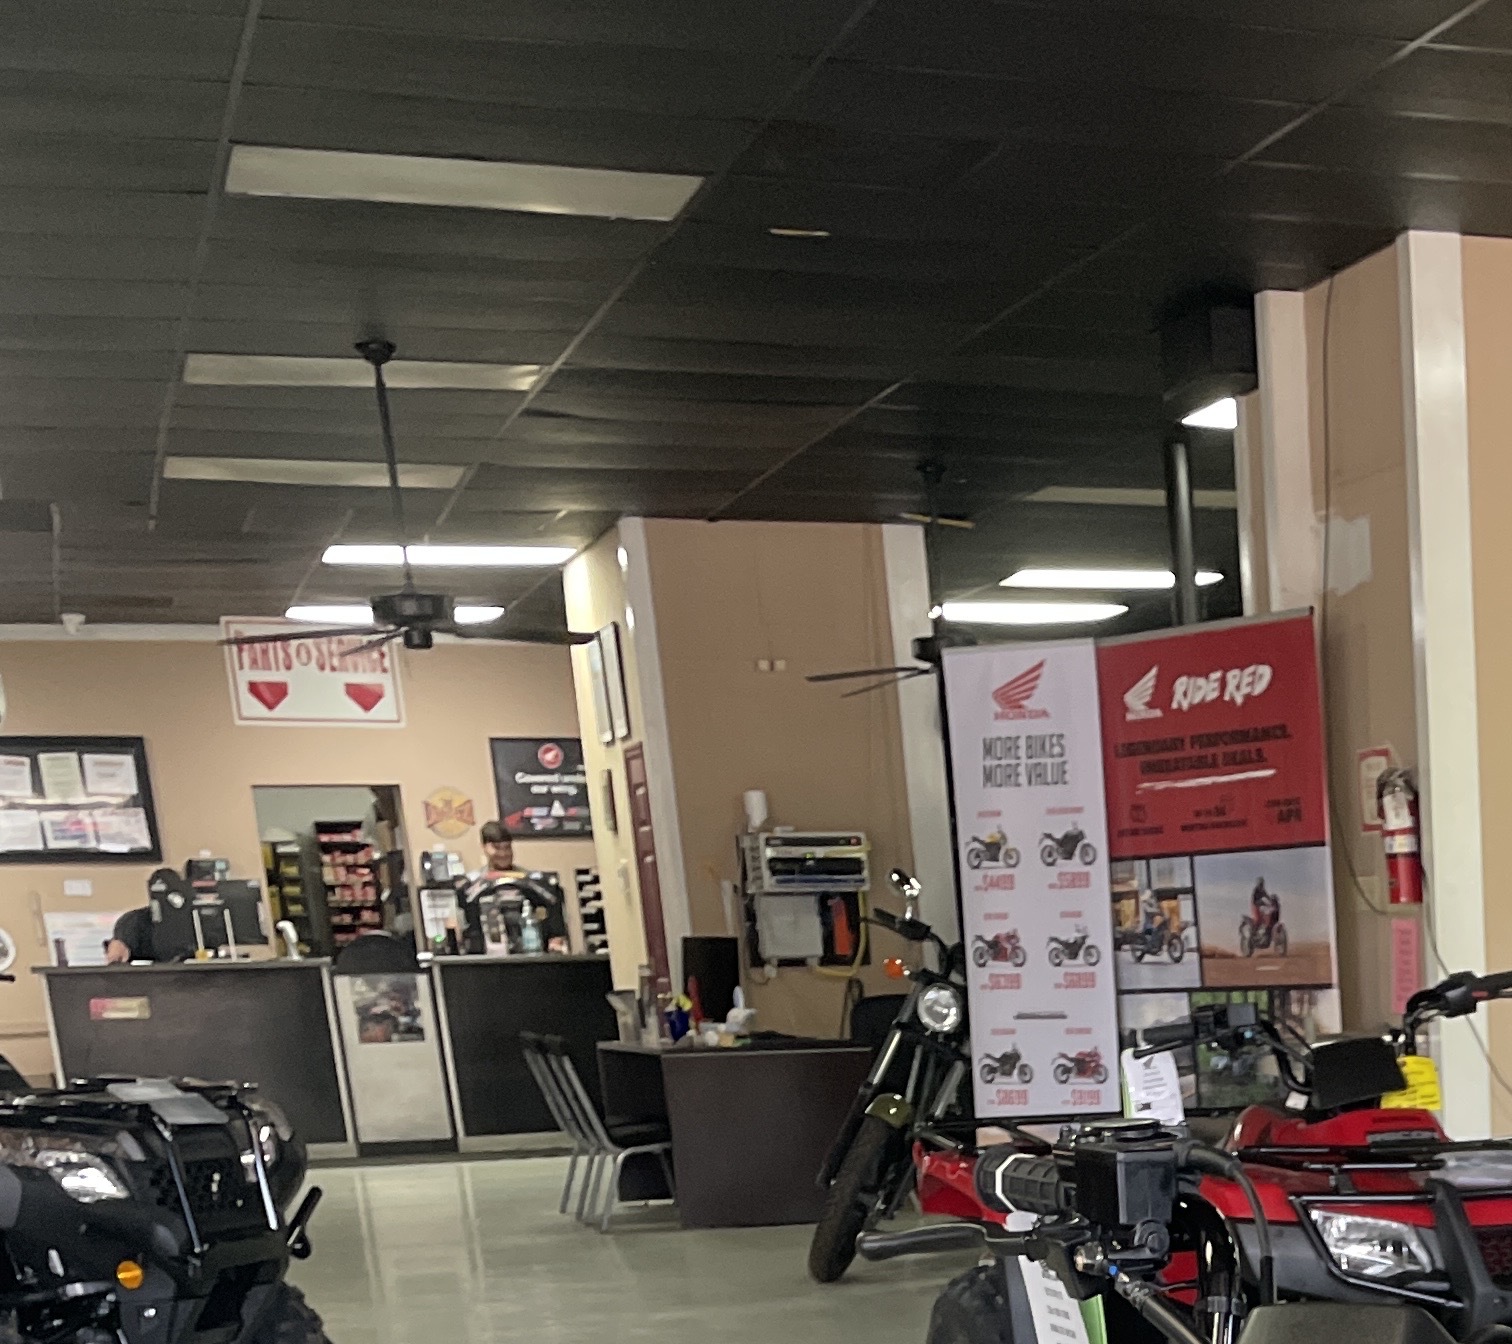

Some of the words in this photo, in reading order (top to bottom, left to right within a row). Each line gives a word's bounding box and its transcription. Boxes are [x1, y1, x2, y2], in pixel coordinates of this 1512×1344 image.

[1170, 669, 1223, 712] RIDE
[1223, 664, 1273, 706] RED
[982, 735, 1021, 761] MORE
[1025, 733, 1066, 760] BIKES
[982, 763, 1022, 789] MORE
[1025, 761, 1069, 787] VALUE
